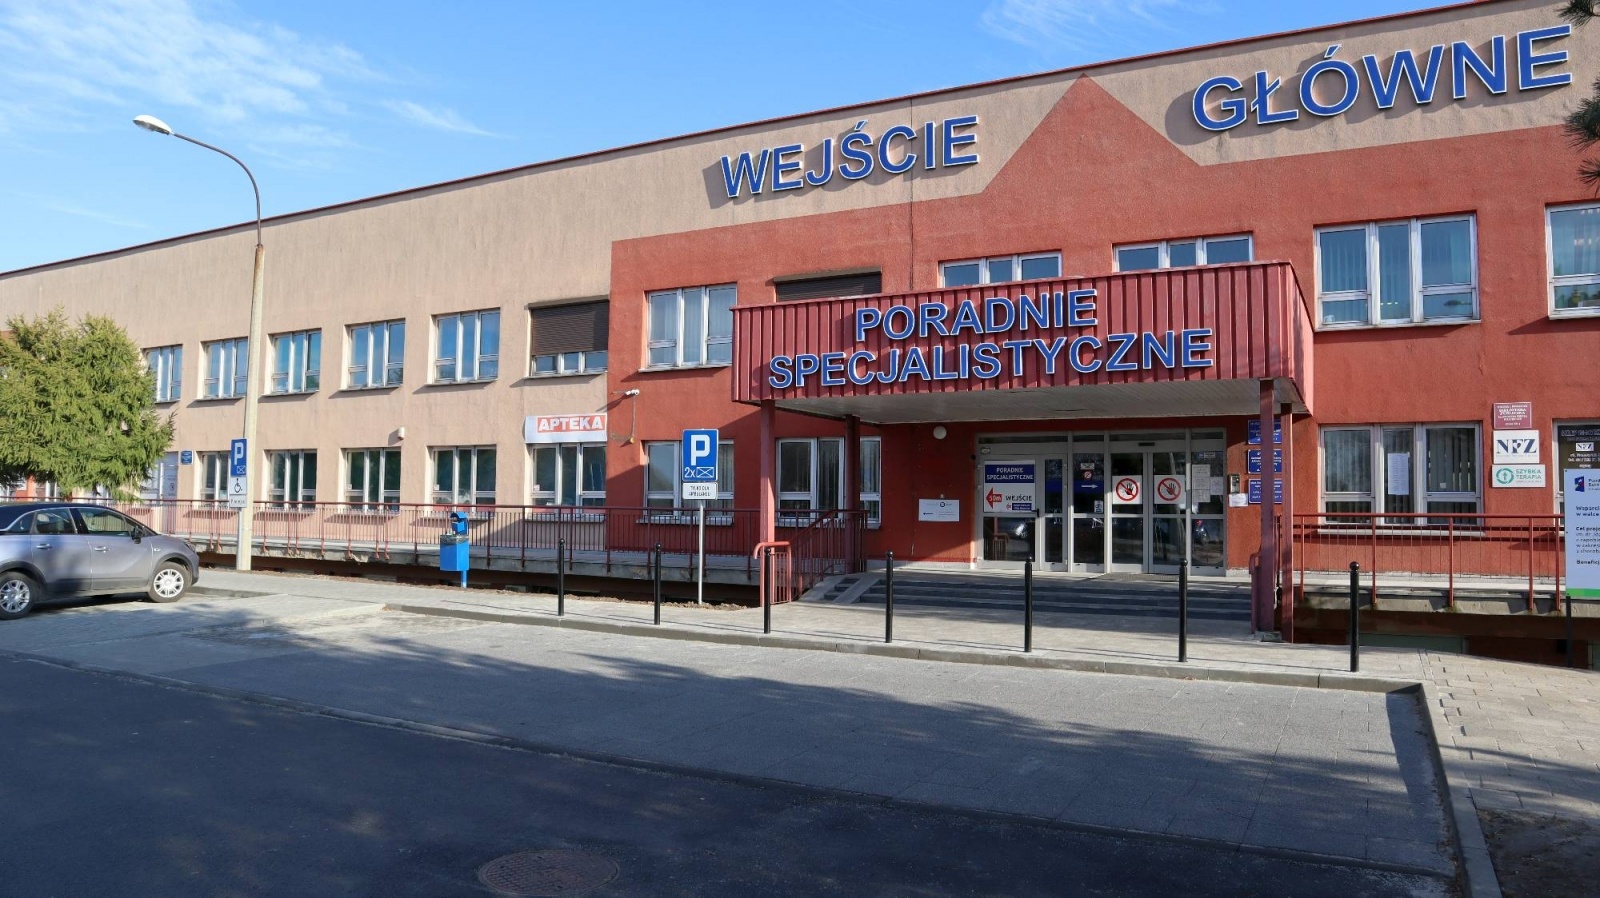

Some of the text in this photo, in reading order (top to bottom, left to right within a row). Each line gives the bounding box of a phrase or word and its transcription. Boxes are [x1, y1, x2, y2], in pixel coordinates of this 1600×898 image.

[720, 24, 1572, 198] WEJŚCIE GŁÓWNE
[856, 288, 1098, 342] PORADNIE
[768, 328, 1214, 389] SPECJALISTYCZNE
[538, 416, 603, 431] APTEKA
[234, 441, 244, 466] P
[690, 434, 711, 466] P
[1496, 439, 1538, 454] NFZ
[684, 466, 696, 478] 2x
[1005, 493, 1033, 502] WEJŚCIE
